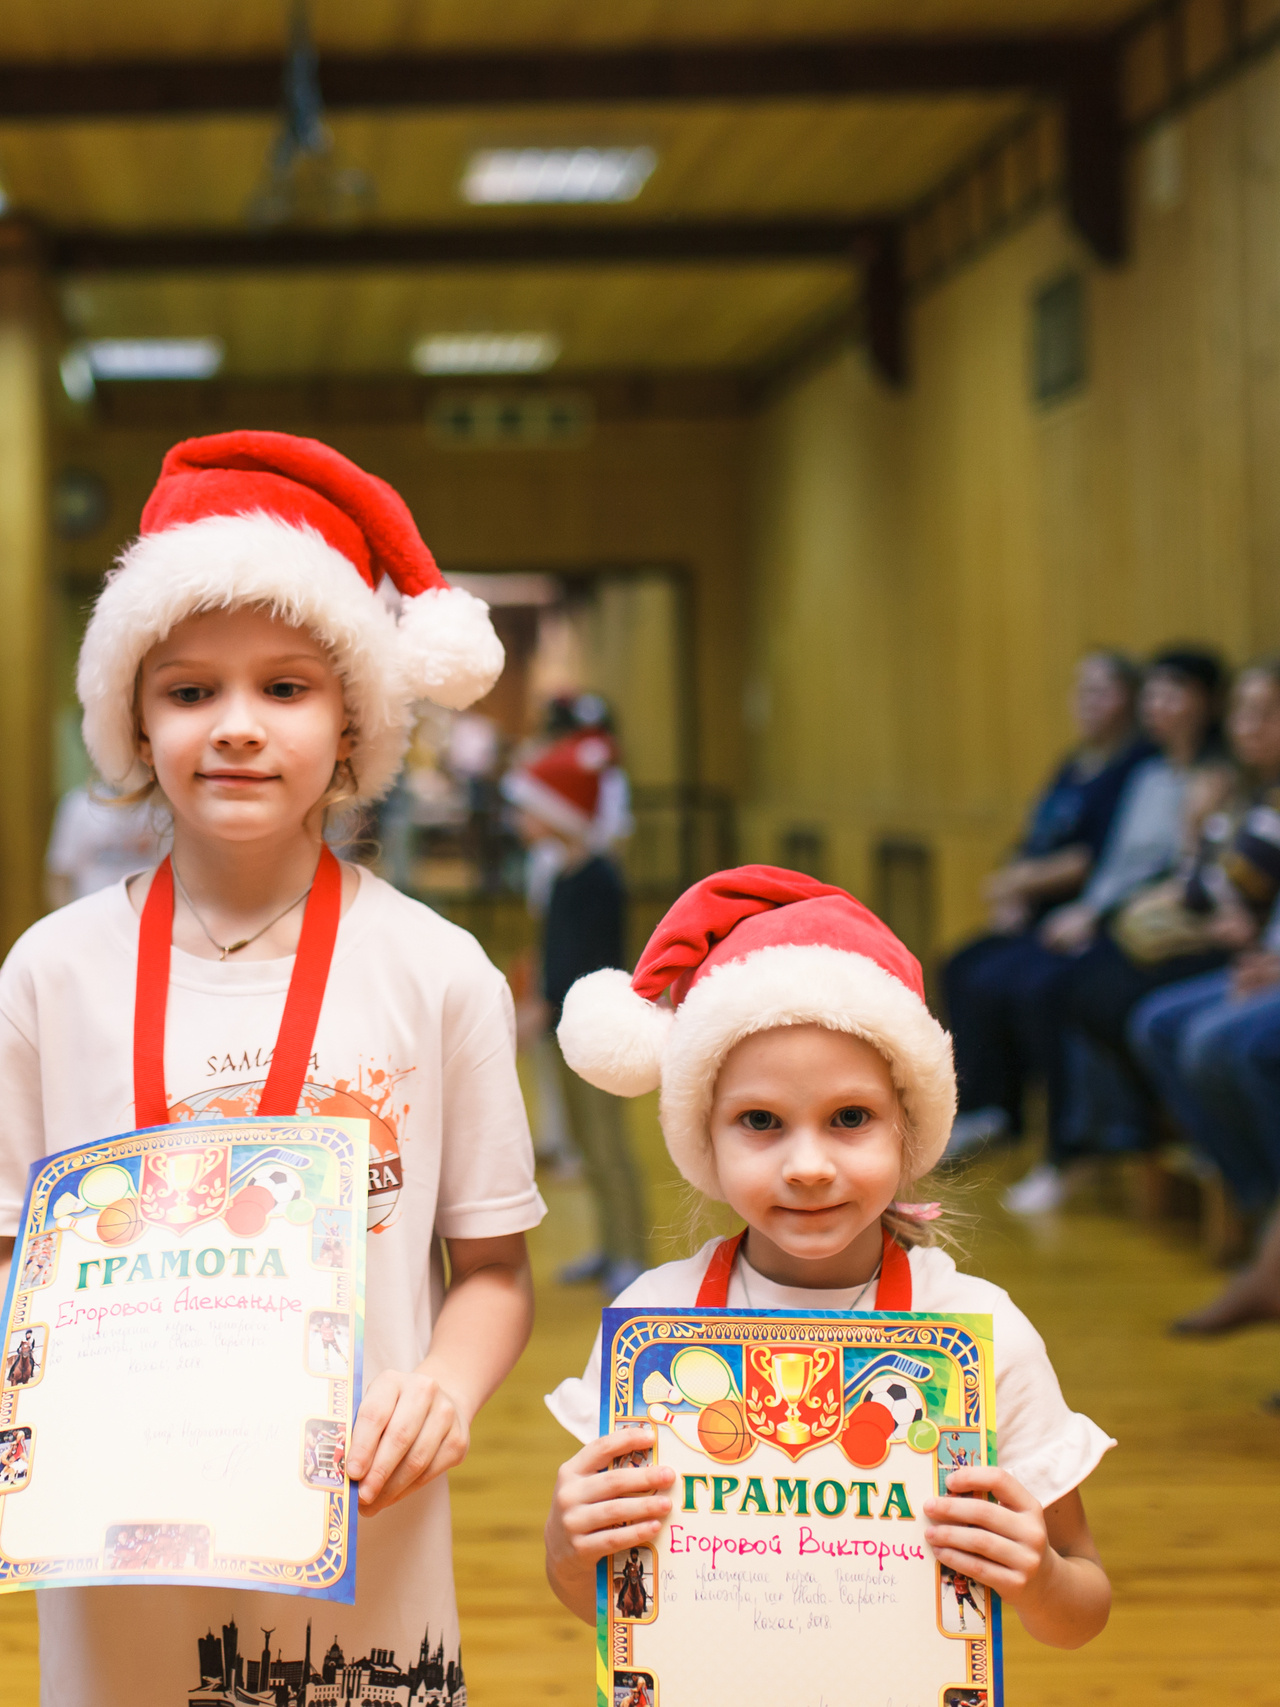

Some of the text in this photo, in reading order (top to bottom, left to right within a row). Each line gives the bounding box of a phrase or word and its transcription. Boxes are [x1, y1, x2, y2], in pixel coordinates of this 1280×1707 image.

[205, 1047, 320, 1077] SAMAA
[75, 1247, 290, 1292] ГРАМОТА
[55, 1296, 163, 1335] Егоровой
[173, 1285, 303, 1322] Александре
[681, 1473, 917, 1521] ГРАМОТА
[669, 1524, 925, 1571] Егоровой Виктории
